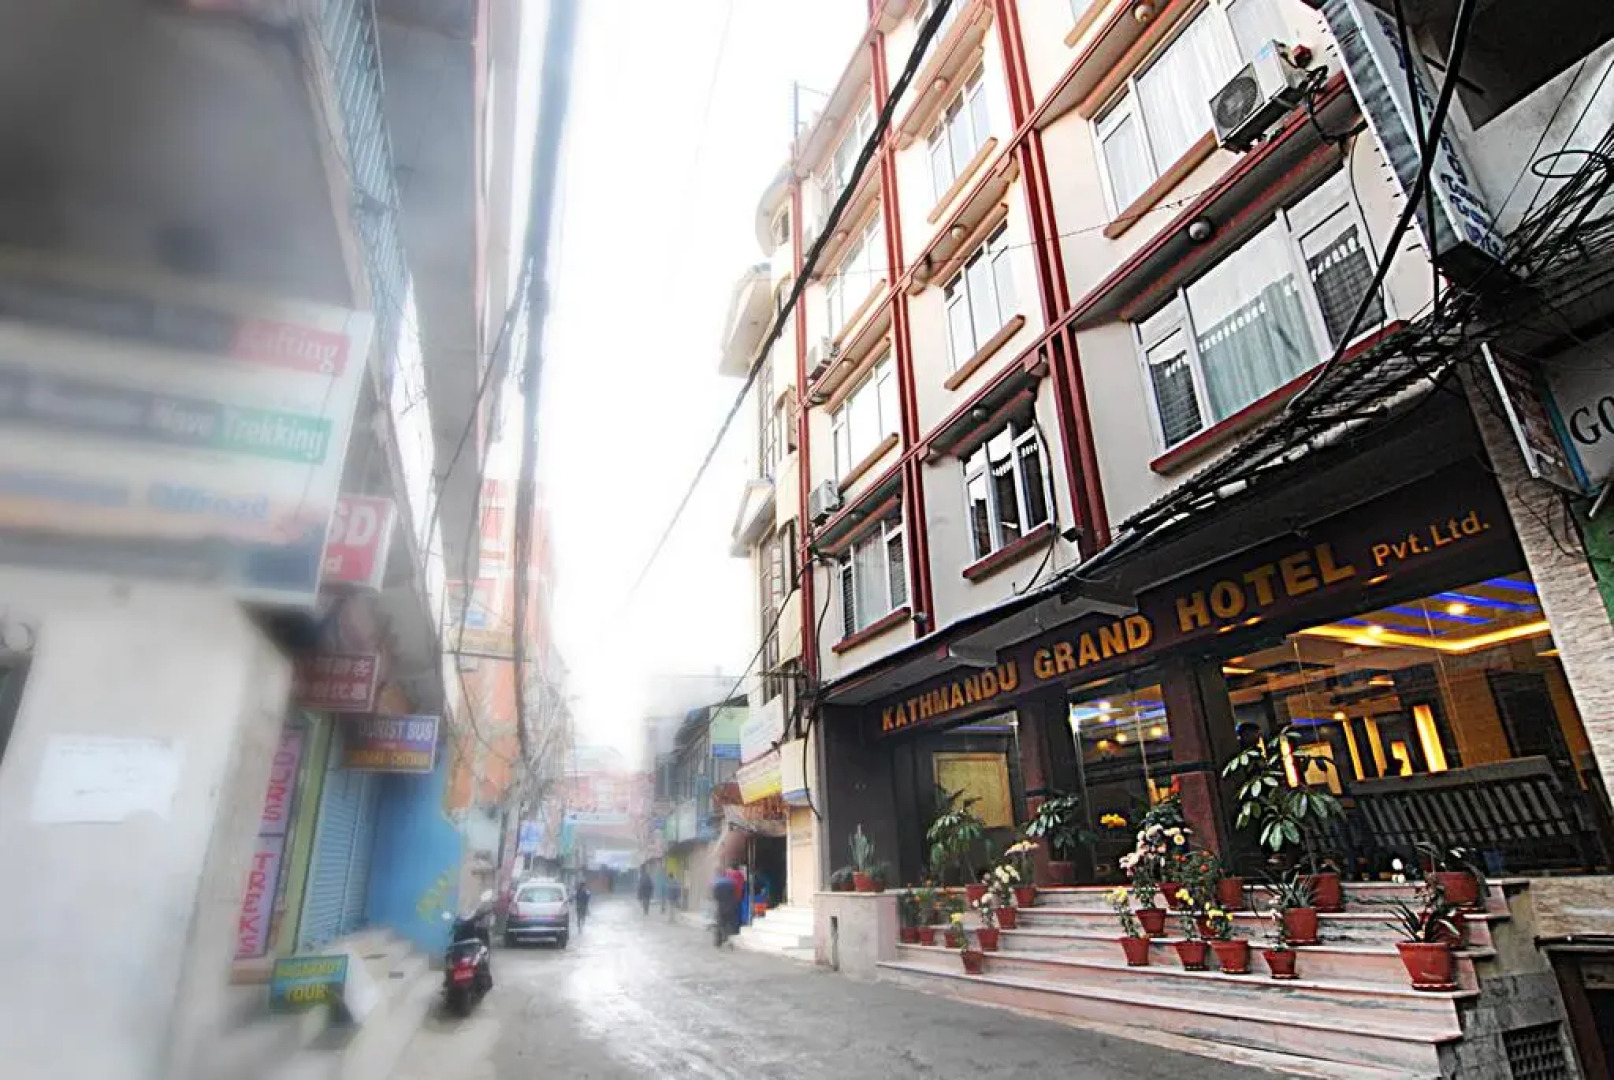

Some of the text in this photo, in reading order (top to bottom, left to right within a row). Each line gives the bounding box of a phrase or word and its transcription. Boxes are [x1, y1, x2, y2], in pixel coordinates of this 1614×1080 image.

[242, 322, 338, 374] afting
[882, 660, 1020, 732] KATHMANDU
[1033, 615, 1154, 680] GRAND
[1175, 544, 1357, 632] HOTEL
[354, 717, 433, 742] OURIST BUS
[238, 852, 276, 954] TREKS
